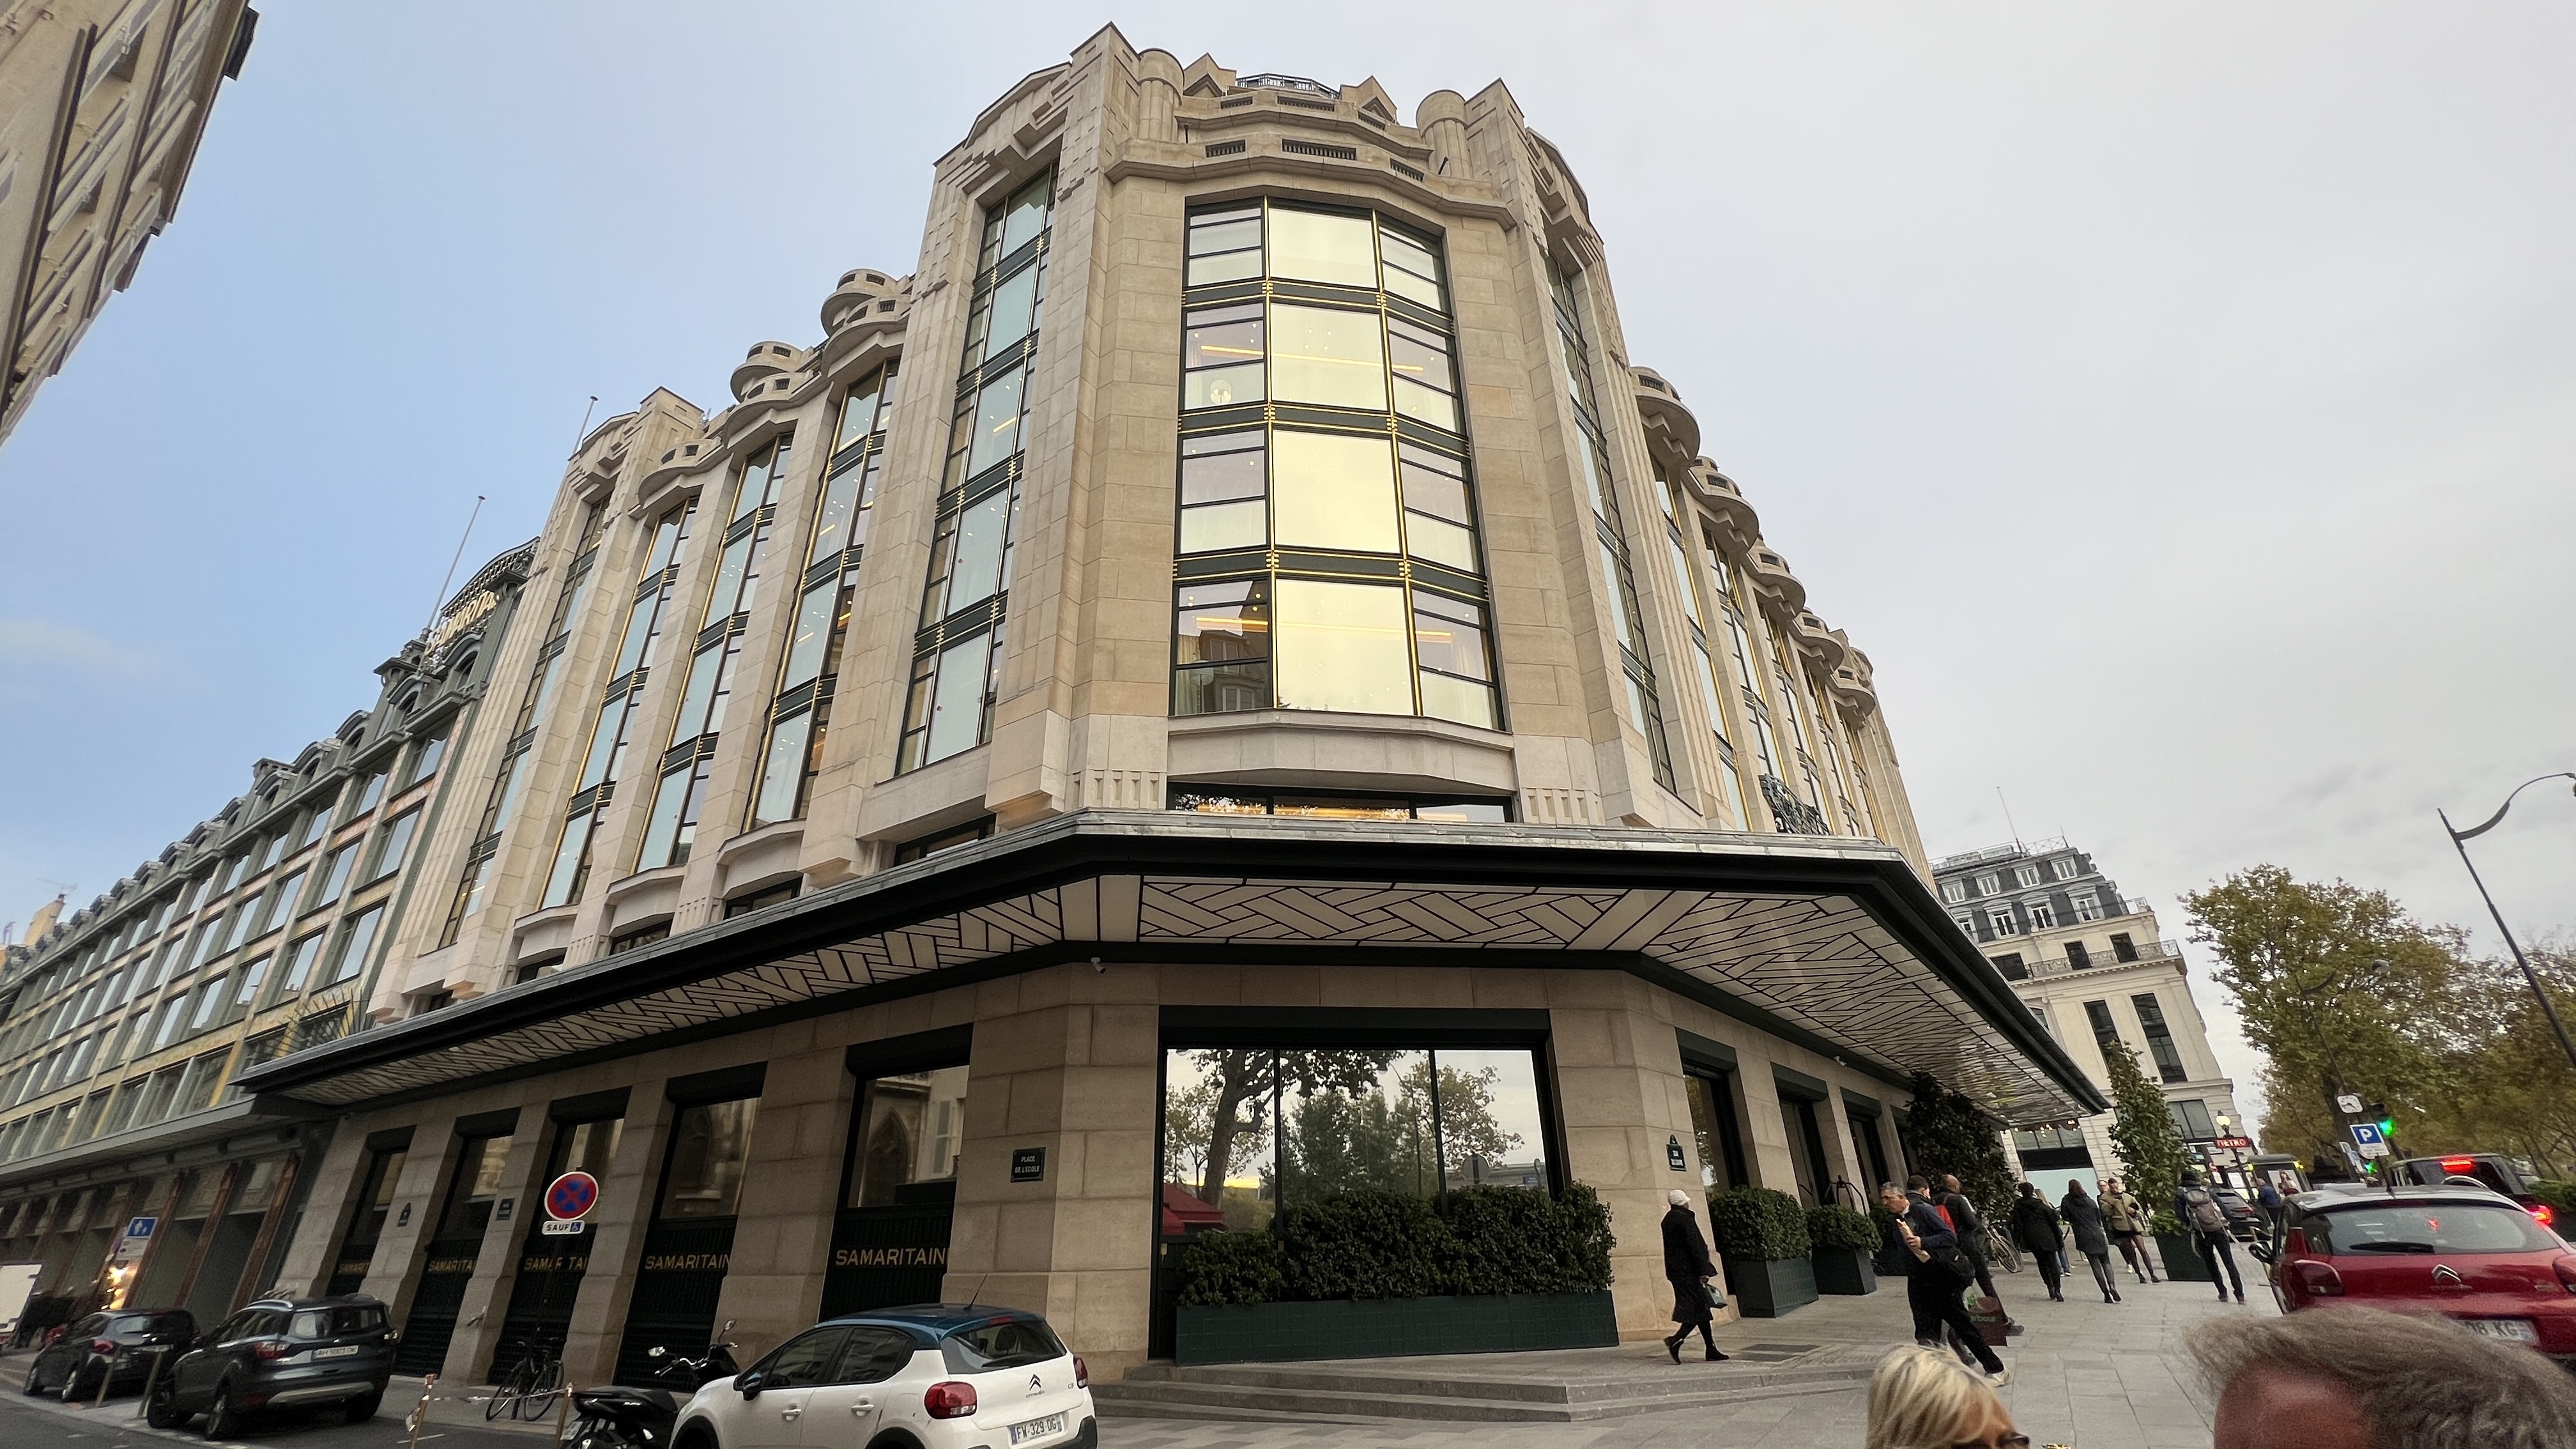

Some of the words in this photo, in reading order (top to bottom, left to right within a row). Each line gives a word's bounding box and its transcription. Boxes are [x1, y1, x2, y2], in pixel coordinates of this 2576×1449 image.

[2358, 1128, 2372, 1142] P
[645, 1254, 730, 1269] SAMARITAIN
[836, 1247, 949, 1266] SAMARITAIN
[1017, 1418, 1057, 1439] FW-329-DG
